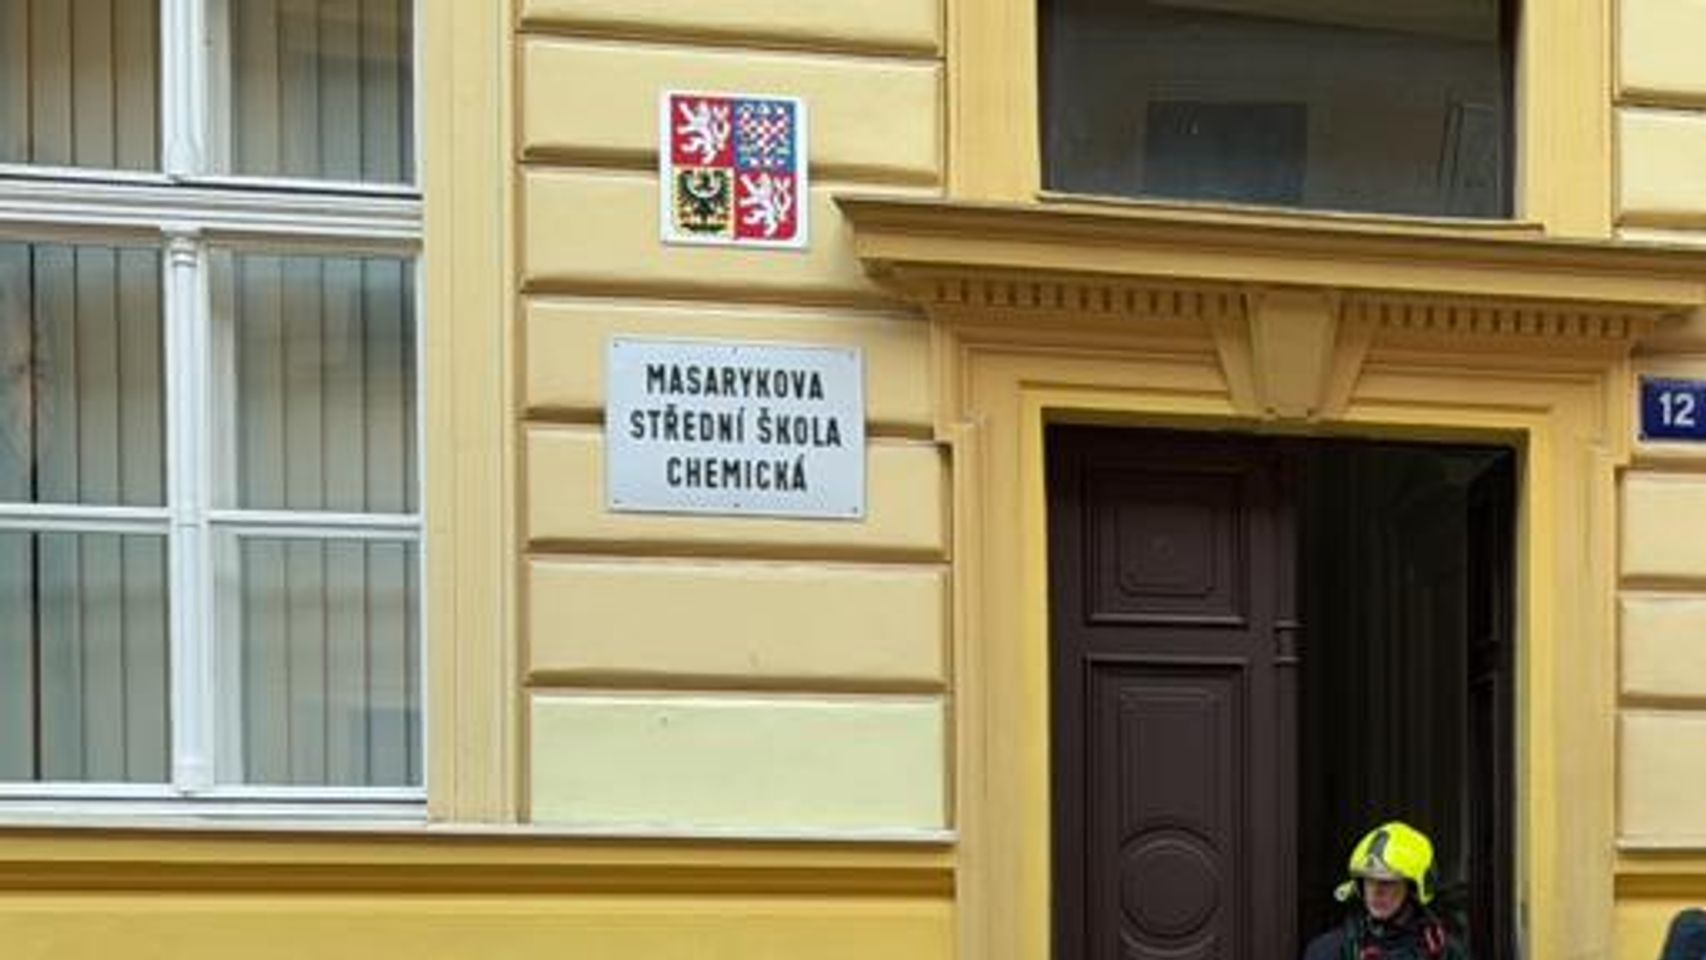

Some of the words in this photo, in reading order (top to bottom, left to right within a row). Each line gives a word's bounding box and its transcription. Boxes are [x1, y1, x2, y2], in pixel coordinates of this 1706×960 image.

[645, 363, 825, 401] MASARYKOVA
[629, 404, 746, 441] STŘEDNÍ
[756, 407, 842, 448] ŠKOLA
[1659, 391, 1695, 427] 12
[666, 454, 808, 491] CHEMICKÁ
